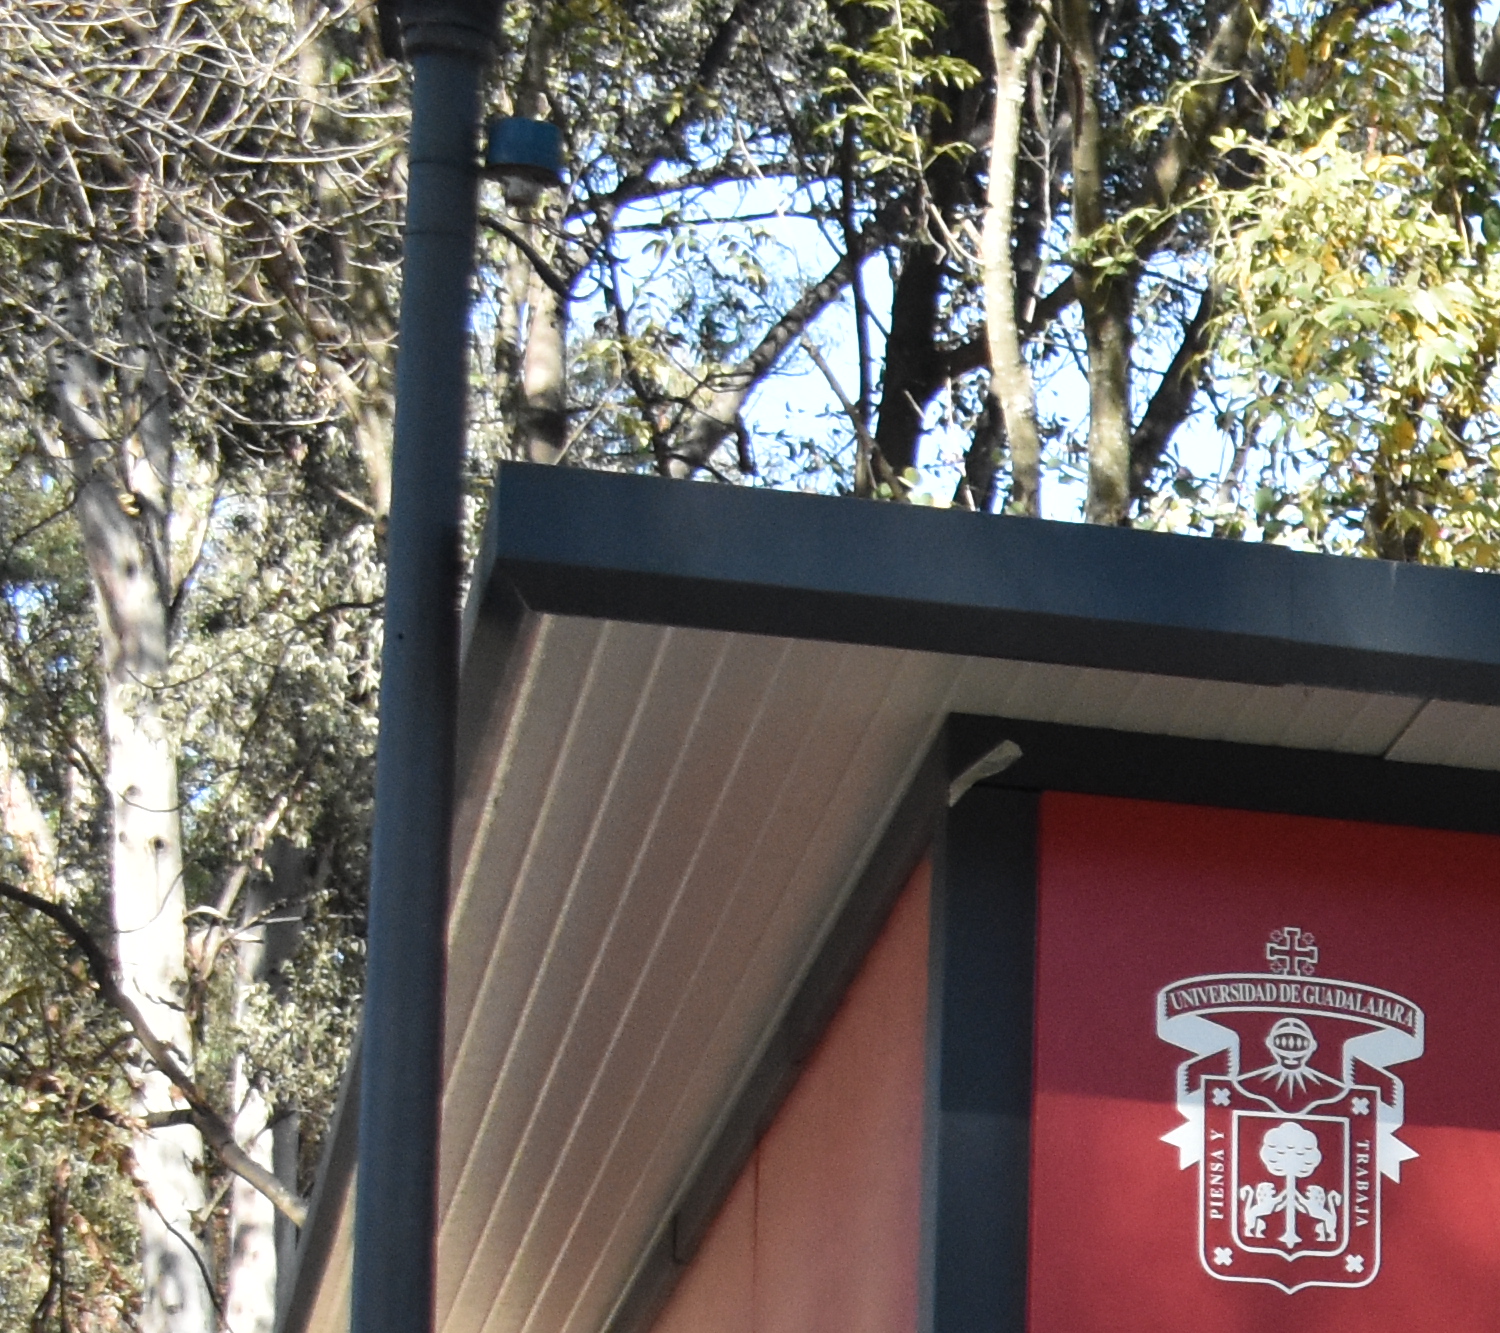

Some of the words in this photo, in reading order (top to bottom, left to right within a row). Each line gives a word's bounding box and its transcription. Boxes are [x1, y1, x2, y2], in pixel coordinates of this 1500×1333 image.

[1168, 982, 1277, 1011] UNIVERSIDAD
[1279, 983, 1302, 1003] DE
[1303, 985, 1414, 1028] GUADALAJARA
[1210, 1129, 1225, 1142] Y
[1210, 1147, 1225, 1220] PIENSA
[1355, 1139, 1370, 1228] TRABAJA
